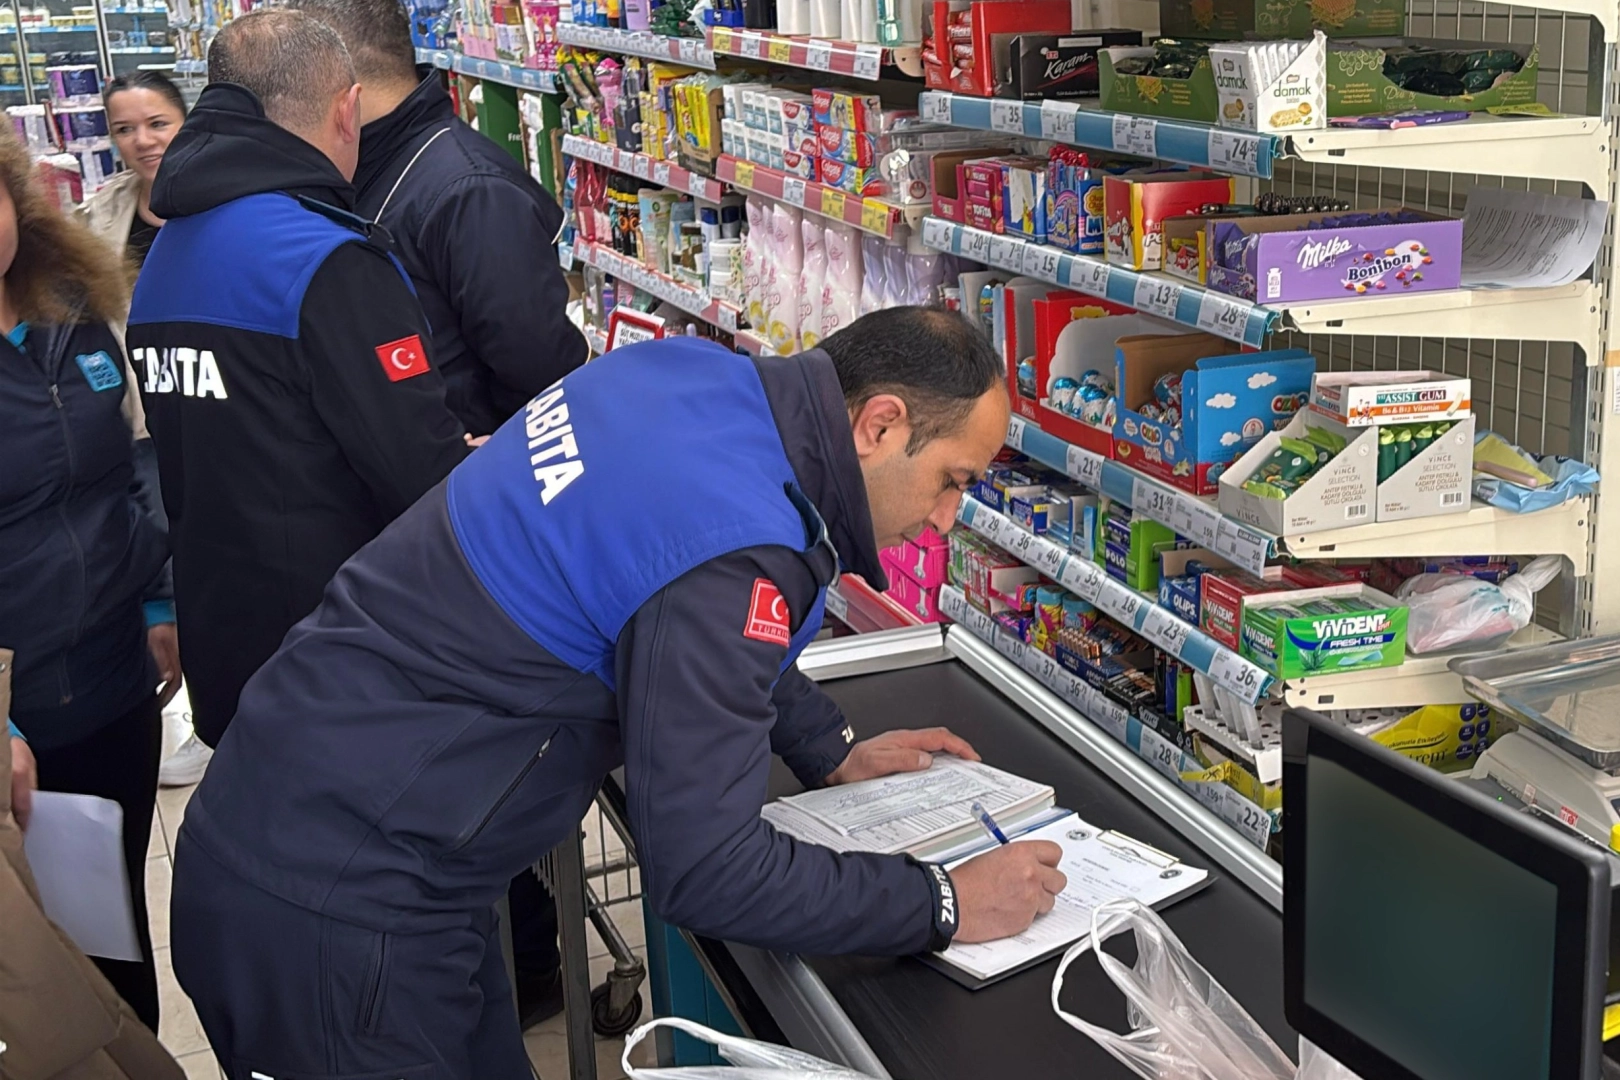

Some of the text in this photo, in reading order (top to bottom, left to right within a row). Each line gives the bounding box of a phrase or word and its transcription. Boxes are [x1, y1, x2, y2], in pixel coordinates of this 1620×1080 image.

[1217, 62, 1248, 90] damak
[1273, 77, 1312, 97] damak
[1297, 236, 1352, 269] Milka
[1348, 253, 1411, 281] Bonibon
[1386, 393, 1417, 404] ASSIST
[1419, 391, 1446, 401] GUM
[1413, 403, 1440, 412] Vitamin
[525, 379, 585, 506] ABITA
[1105, 548, 1126, 568] POLO
[1313, 614, 1387, 639] ViViDENT
[1330, 635, 1383, 648] FRESH TIME
[1236, 664, 1256, 686] 36
